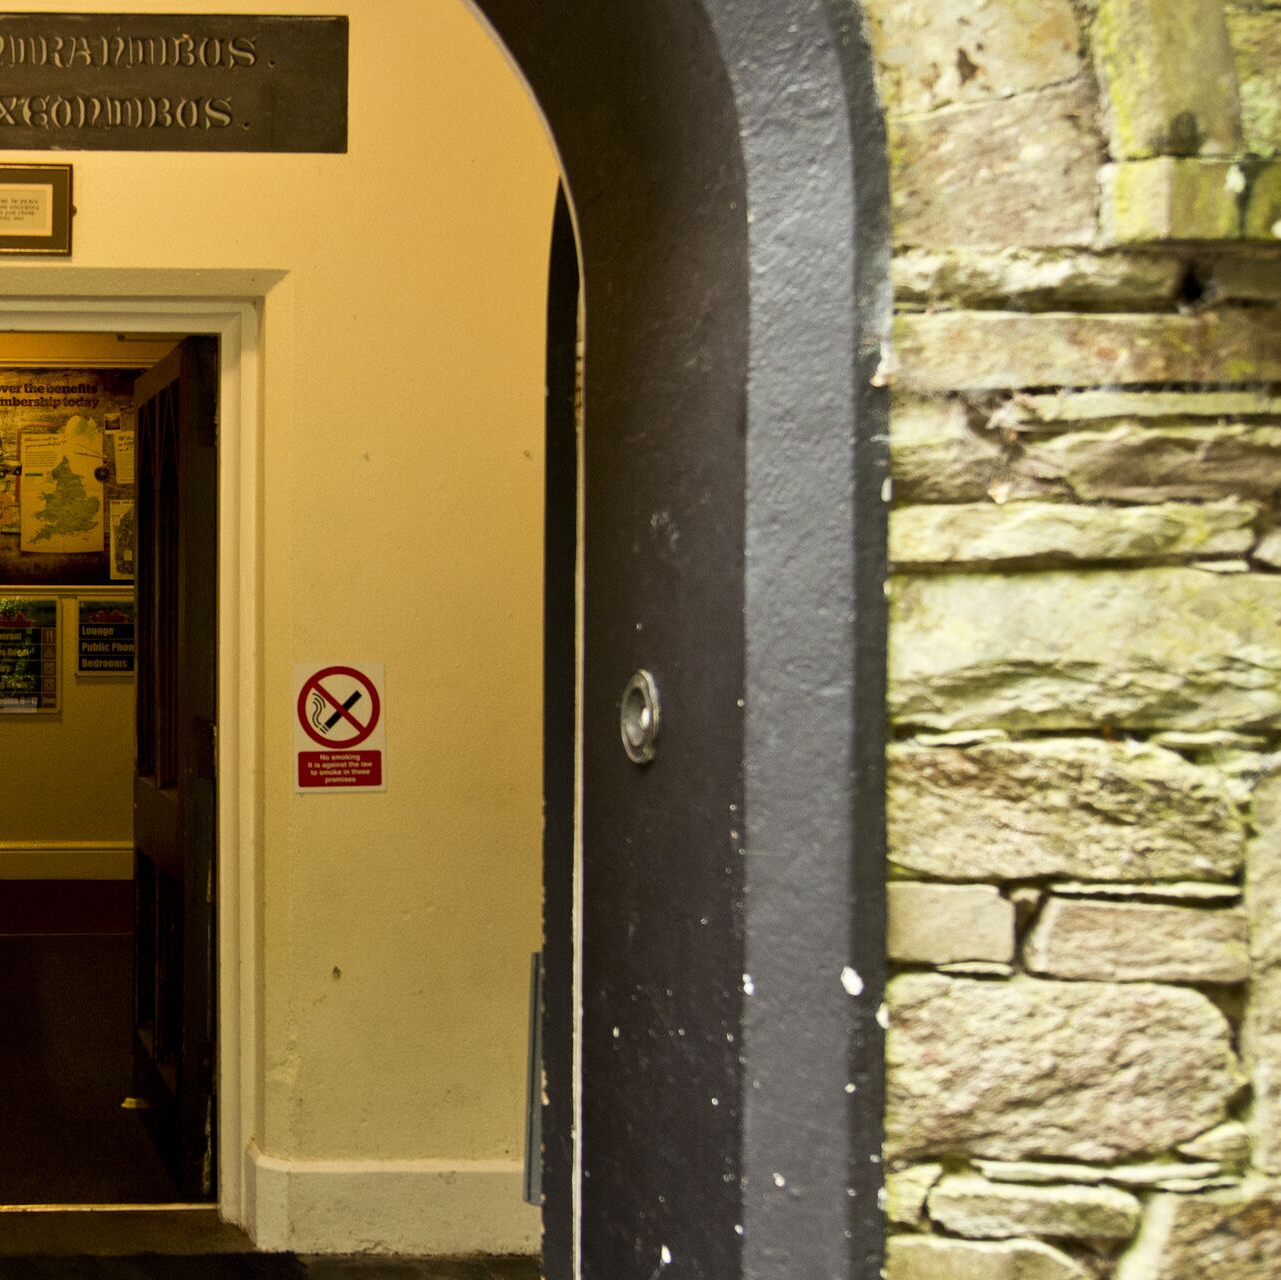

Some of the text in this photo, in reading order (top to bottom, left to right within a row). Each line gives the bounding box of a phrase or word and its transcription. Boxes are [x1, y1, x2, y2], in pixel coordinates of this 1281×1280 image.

[24, 384, 44, 393] the
[46, 384, 98, 393] benefits
[63, 397, 100, 409] today
[82, 626, 114, 636] Lounge
[82, 642, 109, 652] Public
[82, 659, 127, 668] Bedrooms
